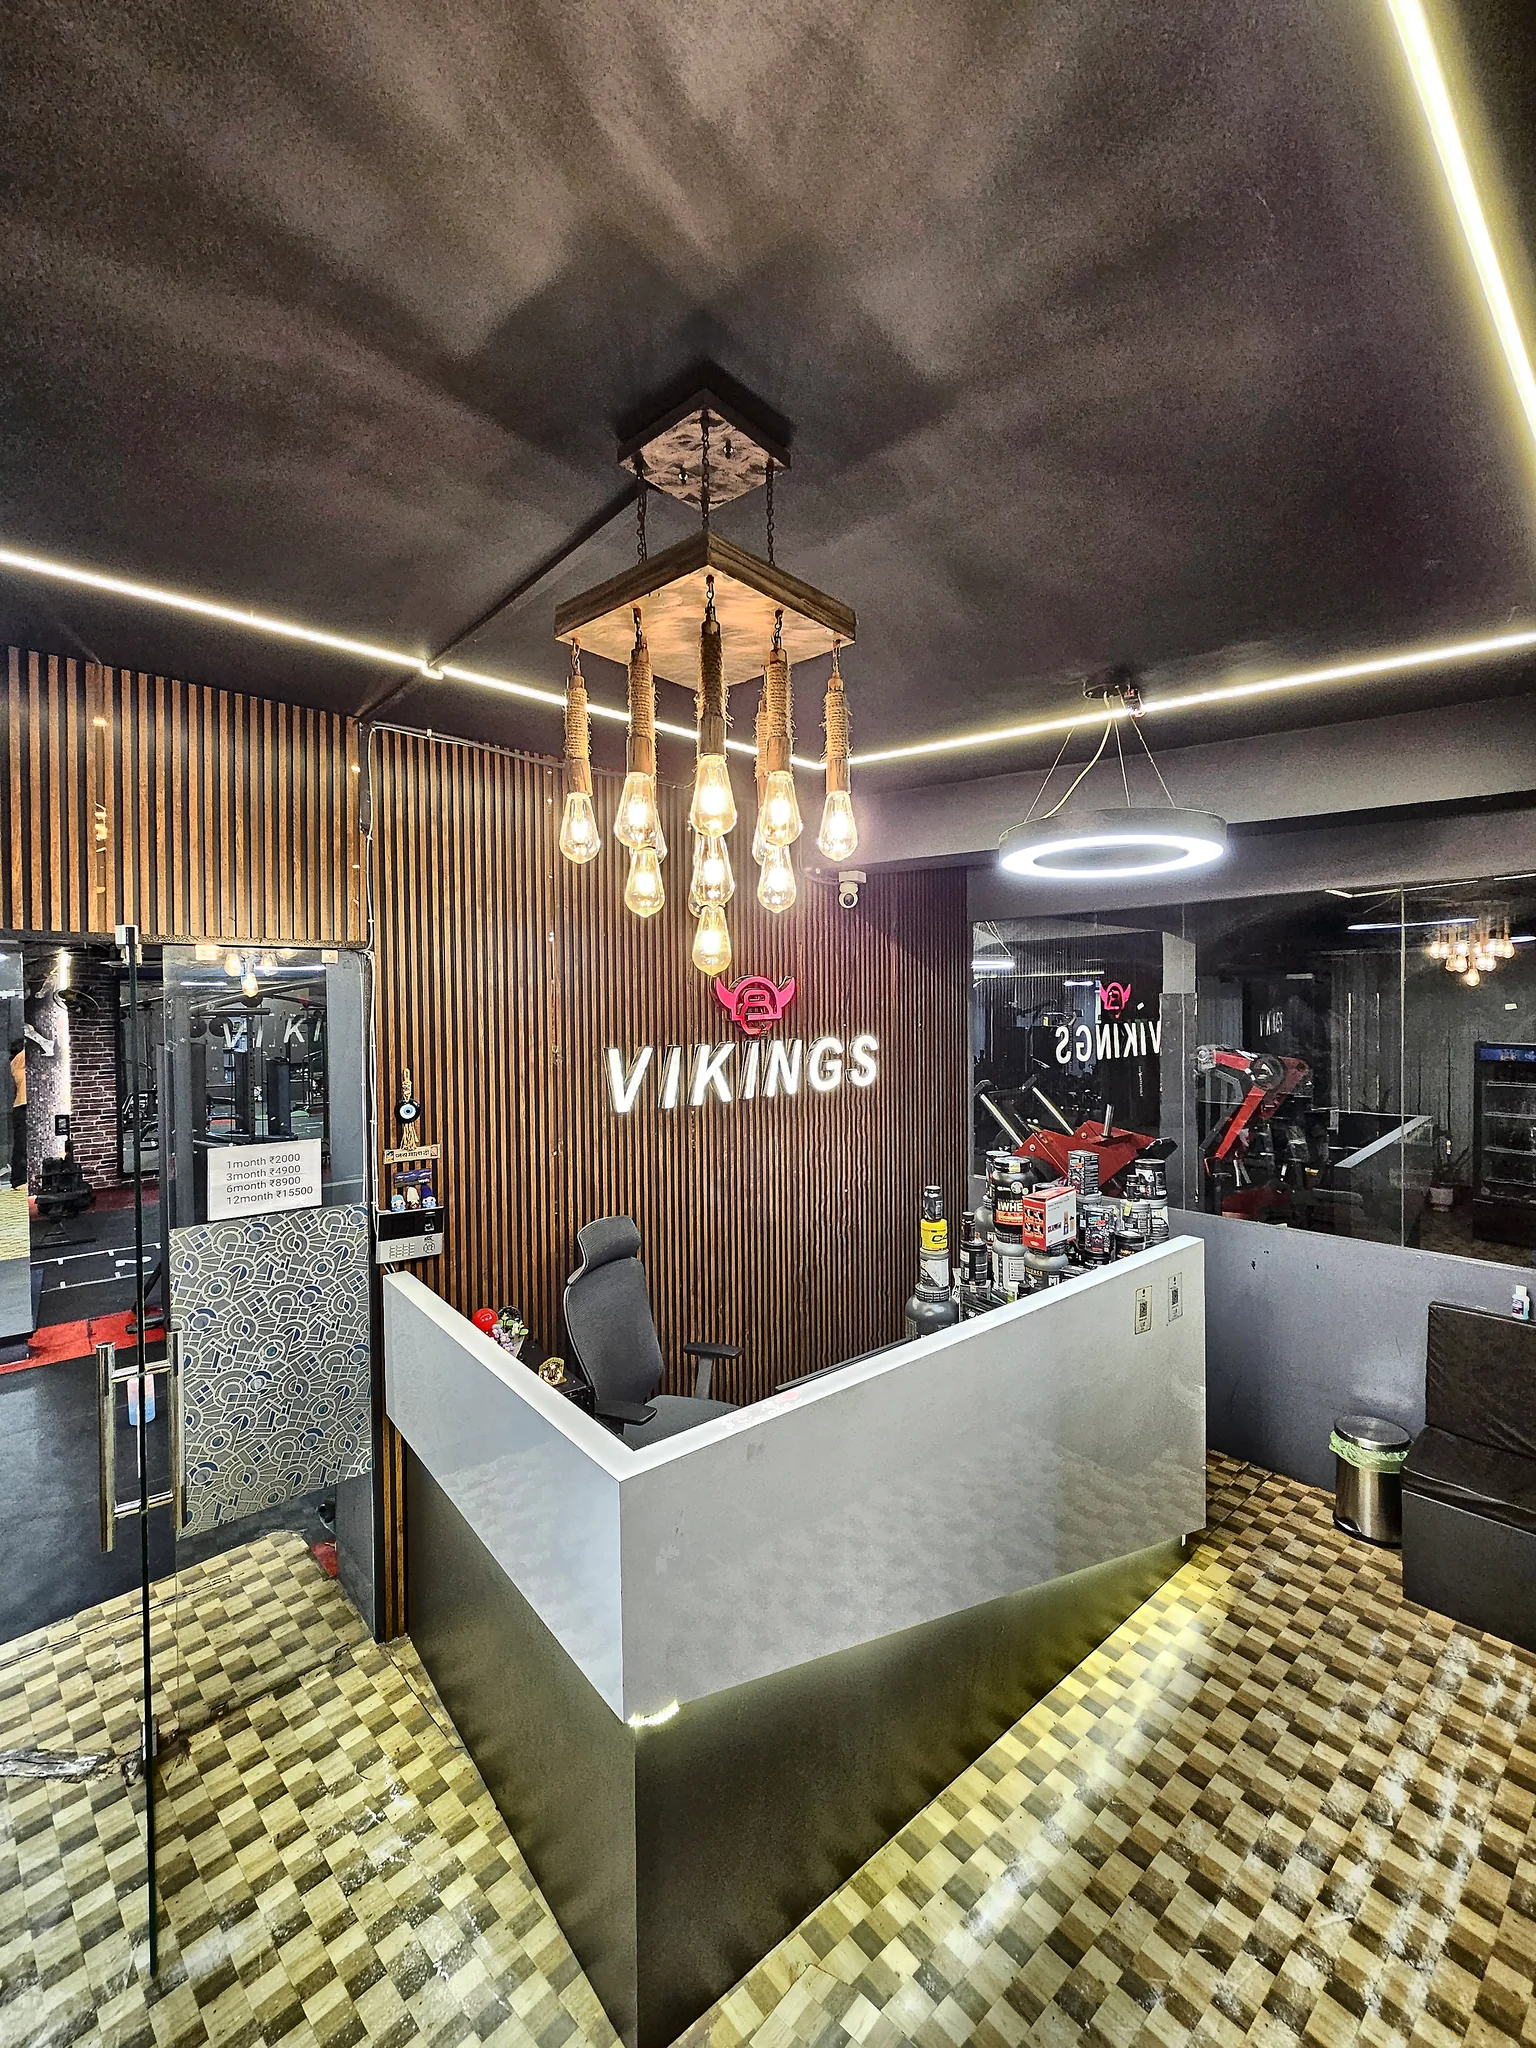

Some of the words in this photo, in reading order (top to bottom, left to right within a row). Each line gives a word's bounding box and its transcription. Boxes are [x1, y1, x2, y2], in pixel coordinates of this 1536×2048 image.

[604, 1034, 878, 1113] VIKINGS
[226, 1157, 266, 1169] 1month
[269, 1153, 300, 1164] ₹2000
[226, 1169, 267, 1181] 3month
[269, 1165, 301, 1176] ₹4900
[226, 1180, 267, 1193] 6month
[269, 1176, 301, 1187] ₹8900
[226, 1192, 273, 1205] 12month
[276, 1186, 313, 1198] ₹15500
